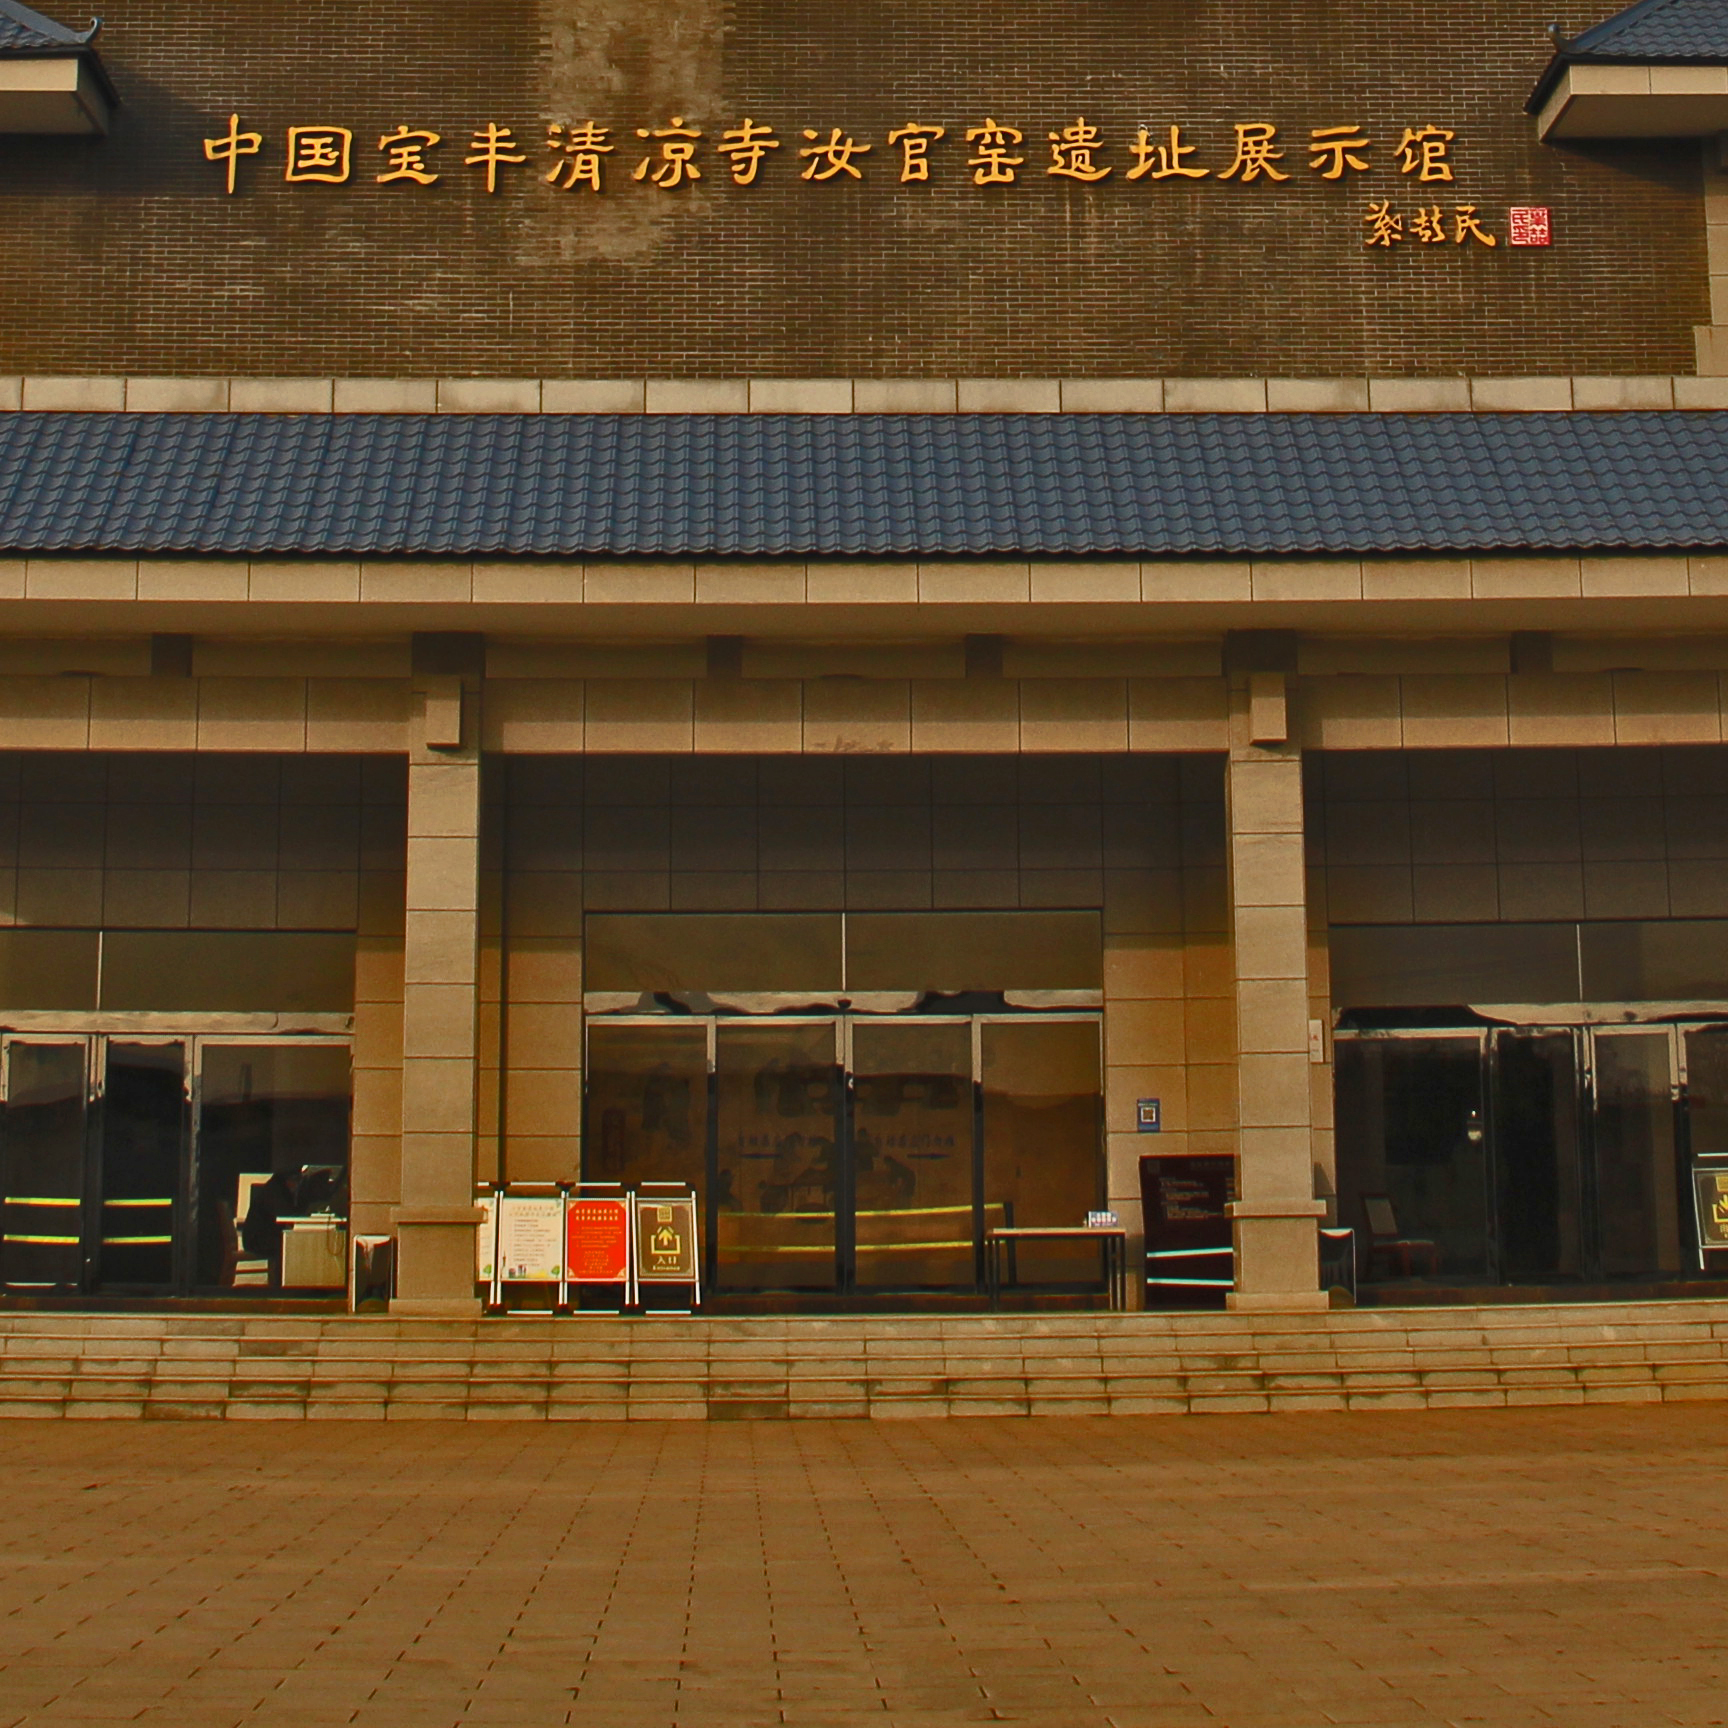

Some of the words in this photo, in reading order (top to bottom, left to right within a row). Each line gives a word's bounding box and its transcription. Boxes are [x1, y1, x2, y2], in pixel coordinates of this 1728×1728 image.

[203, 113, 1455, 194] 中国宝丰清凉寺汝官窑遗址展示馆
